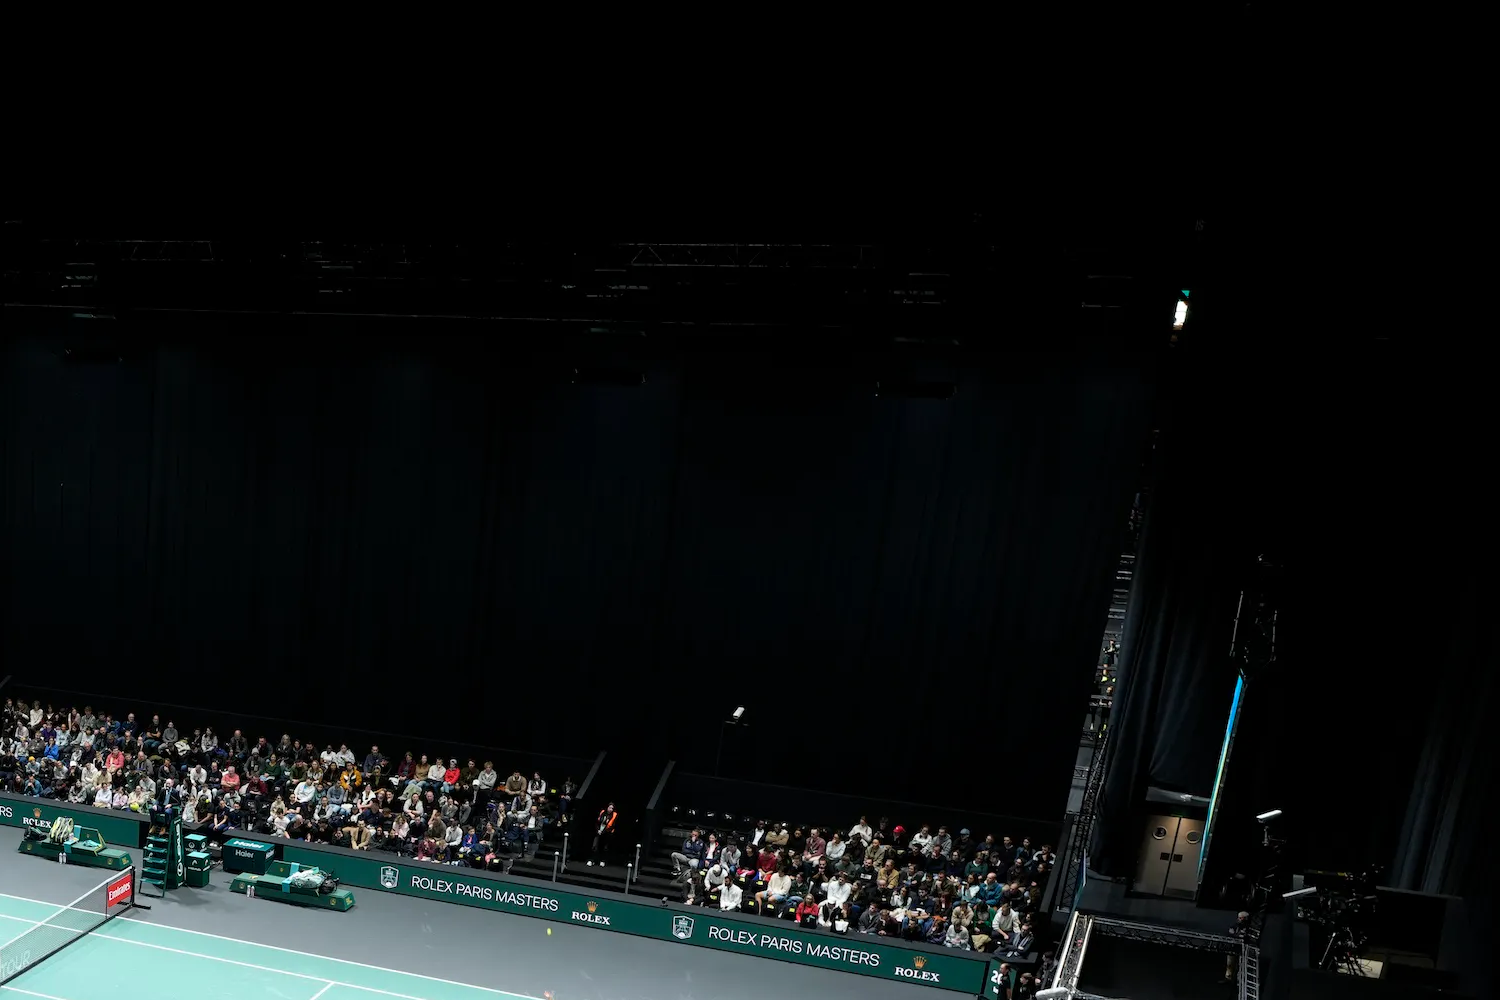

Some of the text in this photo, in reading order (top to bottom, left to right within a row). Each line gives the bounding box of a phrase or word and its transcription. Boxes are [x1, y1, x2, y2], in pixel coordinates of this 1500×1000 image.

[235, 849, 254, 858] Haier
[109, 882, 130, 901] Emirates
[411, 875, 559, 912] ROLEX PARIS MASTERS
[571, 911, 610, 926] ROLEX
[708, 926, 880, 967] ROLEX PARIS MASTERS
[894, 966, 940, 983] ROLEX
